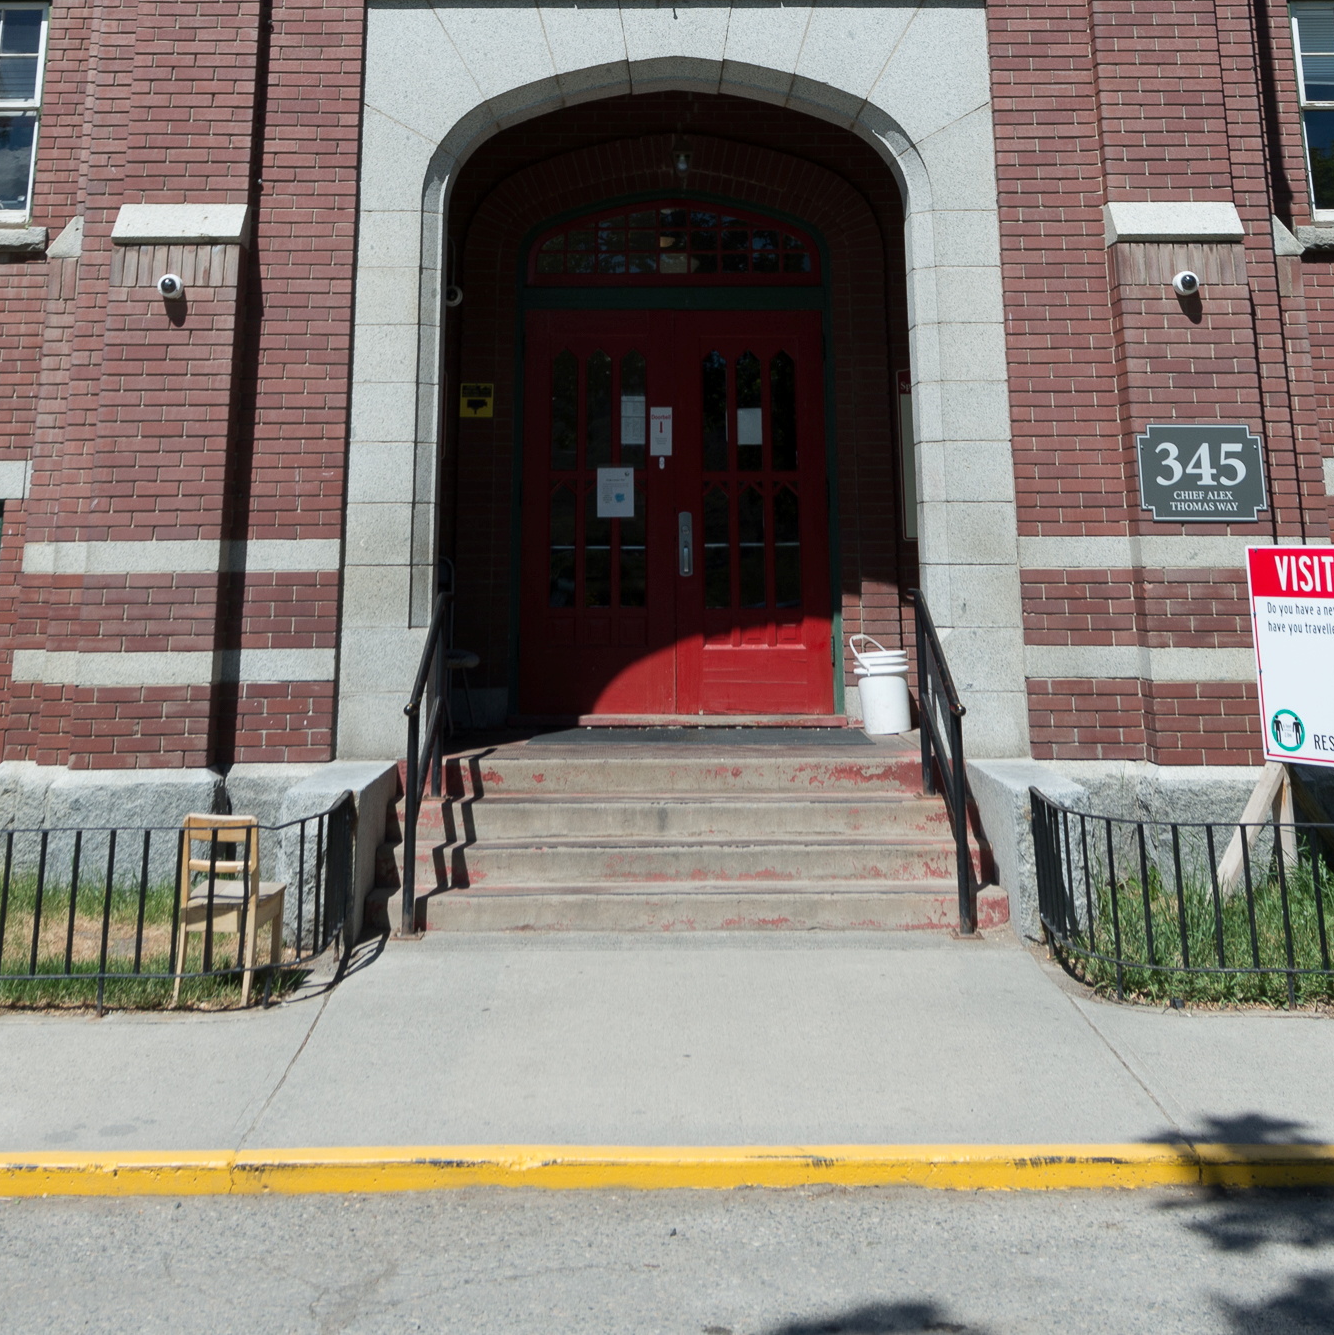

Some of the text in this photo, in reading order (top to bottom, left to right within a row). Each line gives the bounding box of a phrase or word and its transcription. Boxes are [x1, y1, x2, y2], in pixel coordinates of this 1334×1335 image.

[1154, 442, 1247, 486] 345
[1173, 490, 1233, 500] CHIEF ALEX
[1170, 502, 1238, 511] THOMAS WAY
[1267, 602, 1276, 614] Do
[1279, 606, 1293, 617] you
[1296, 604, 1313, 615] have
[1317, 607, 1321, 615] a
[1268, 621, 1286, 633] have
[1289, 624, 1302, 635] you
